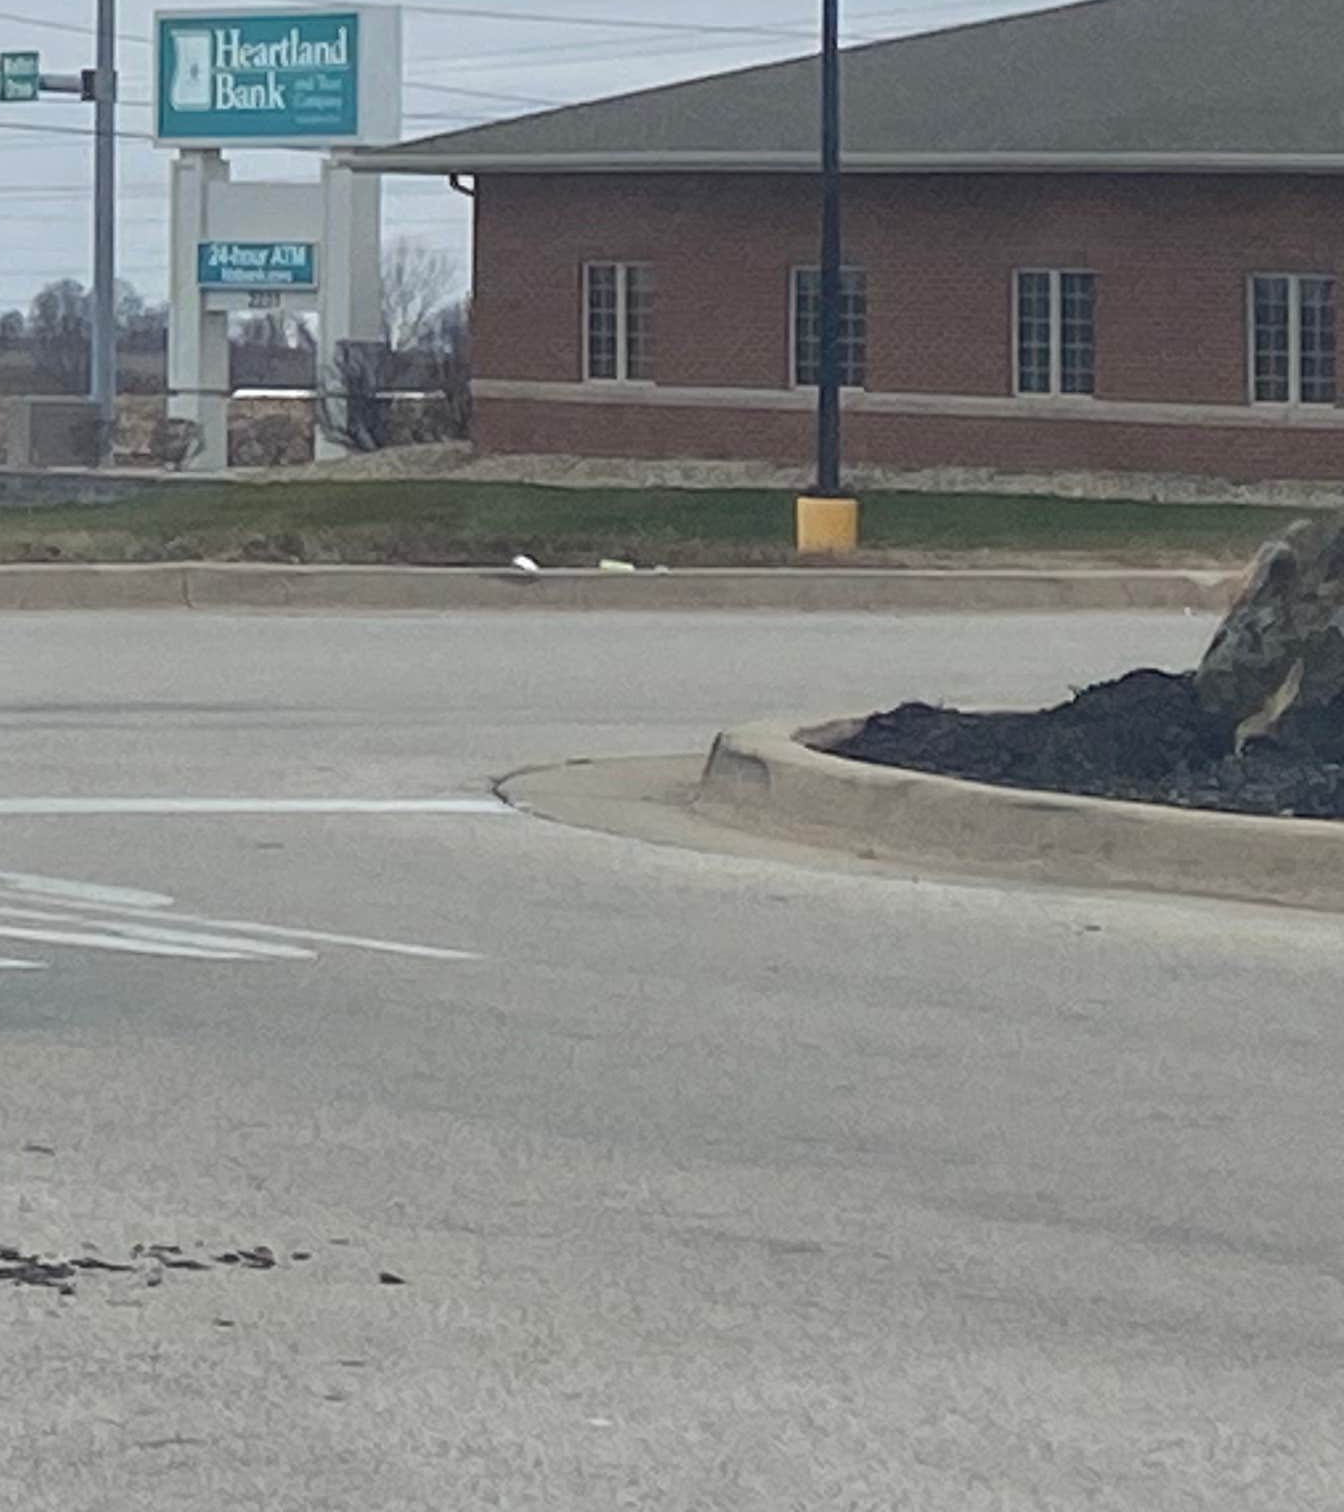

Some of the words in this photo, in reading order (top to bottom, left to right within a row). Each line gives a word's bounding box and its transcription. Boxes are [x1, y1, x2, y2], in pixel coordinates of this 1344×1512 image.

[215, 25, 348, 68] Heartland
[215, 71, 287, 110] Bank
[270, 245, 305, 266] ATM
